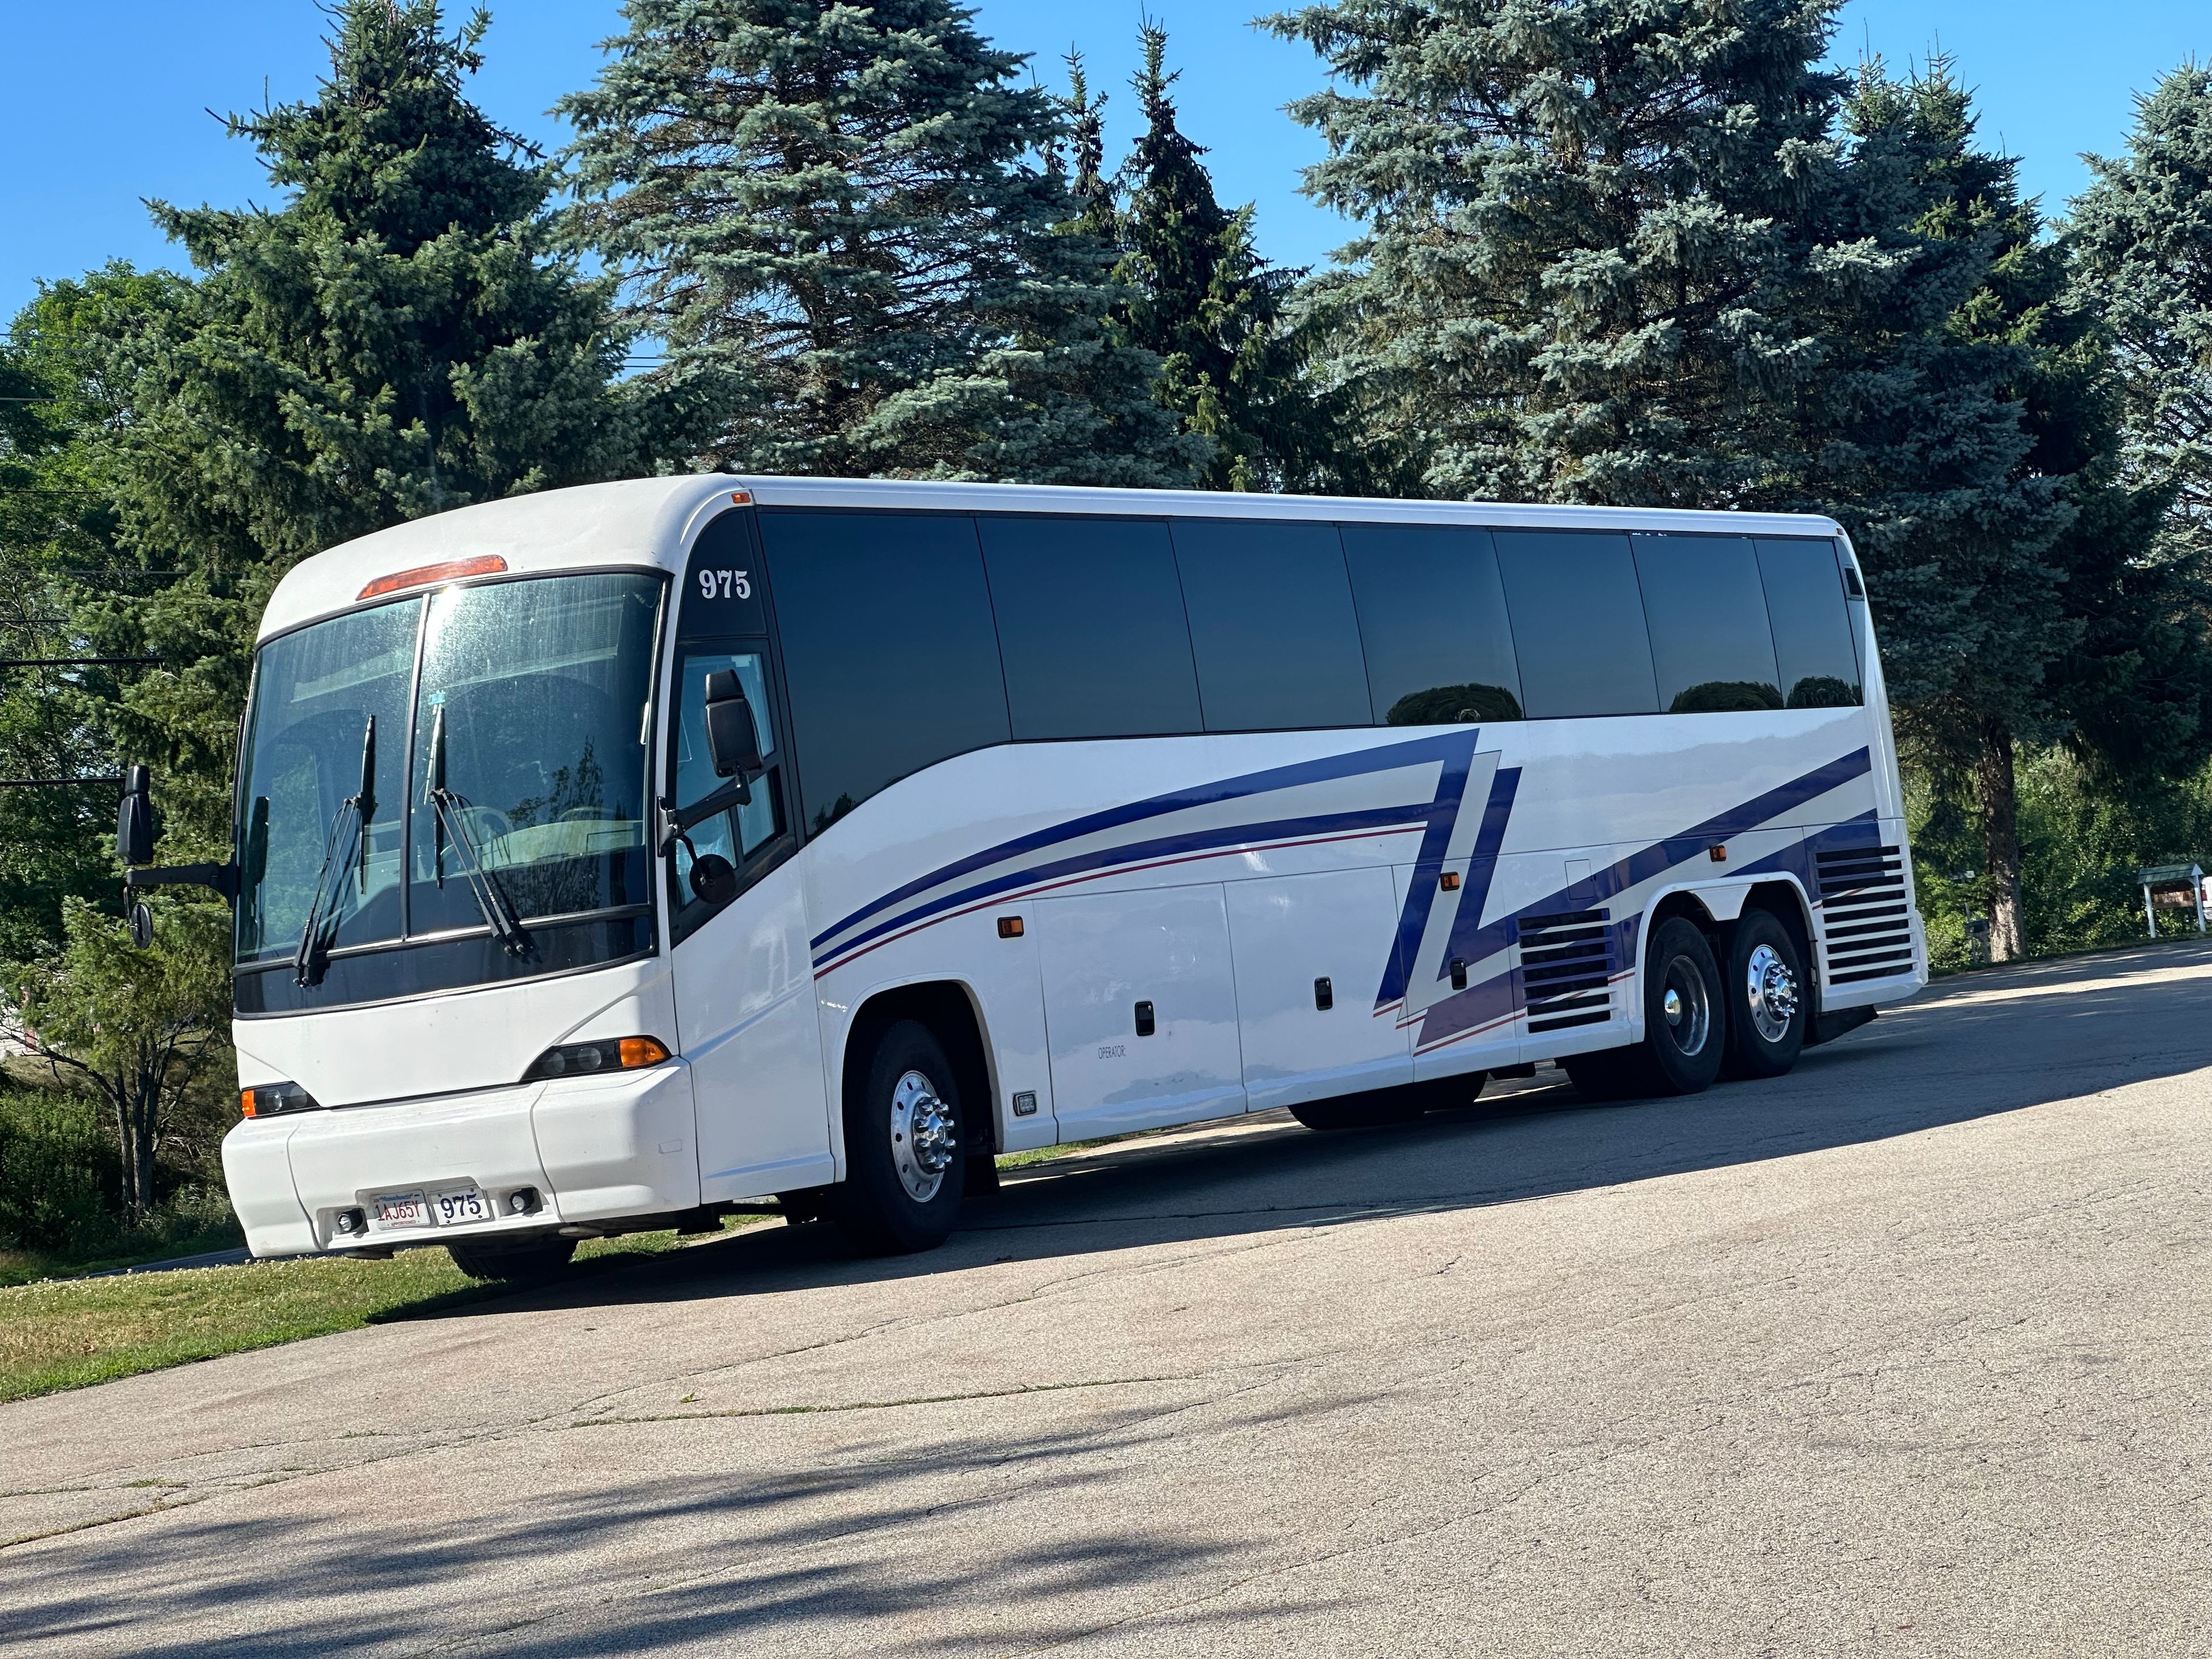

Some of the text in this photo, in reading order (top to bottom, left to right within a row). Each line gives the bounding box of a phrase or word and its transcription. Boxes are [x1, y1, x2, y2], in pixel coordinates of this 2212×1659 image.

[699, 569, 751, 599] 975
[375, 1200, 420, 1221] 1AJ65Y
[441, 1194, 481, 1218] 975
